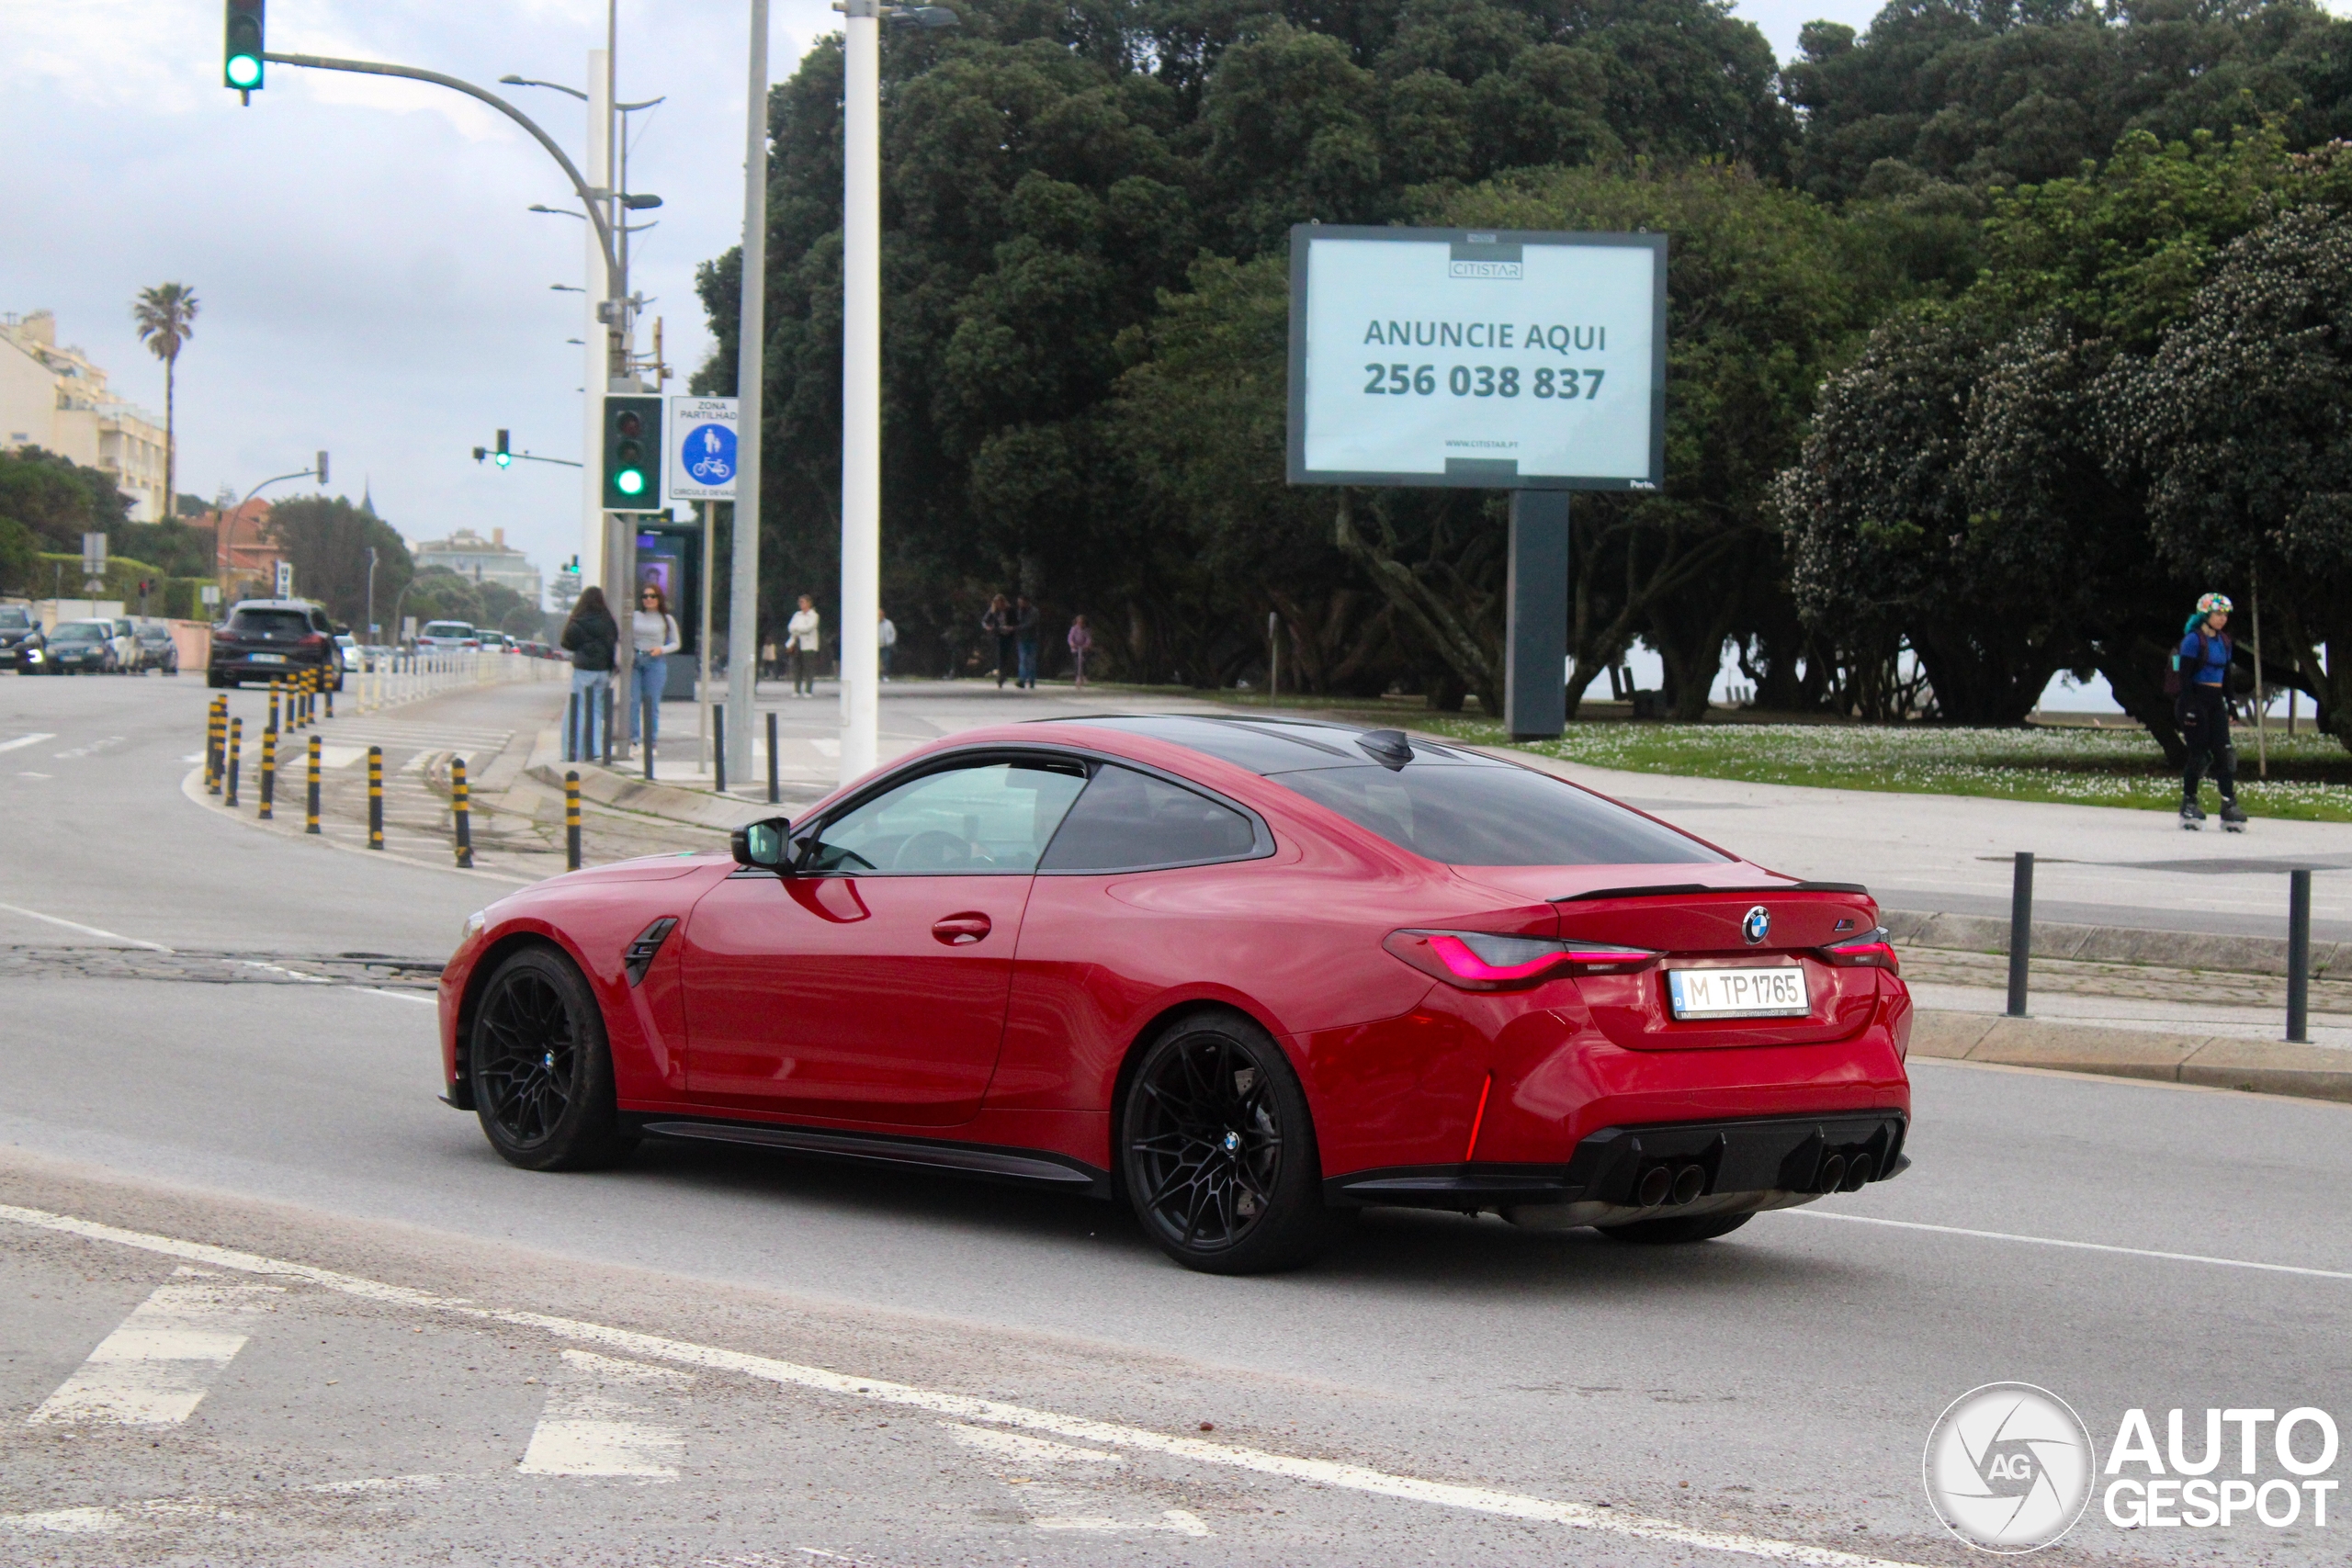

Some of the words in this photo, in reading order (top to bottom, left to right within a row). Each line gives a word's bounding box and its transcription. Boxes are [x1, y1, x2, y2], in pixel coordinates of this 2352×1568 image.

[1453, 263, 1519, 276] CITISTAR
[1363, 320, 1514, 348] ANUNCIE
[1524, 324, 1606, 355] AQUI
[1363, 363, 1436, 396] 256
[1449, 365, 1521, 398] 038
[1533, 367, 1605, 400] 837
[698, 401, 727, 410] ZONA
[680, 410, 737, 420] PARTILHAD
[673, 488, 707, 496] CIRCULE
[1690, 976, 1711, 1006] M
[1675, 997, 1682, 1007] D
[1700, 1009, 1788, 1019] www.autohaus-intermobil.de
